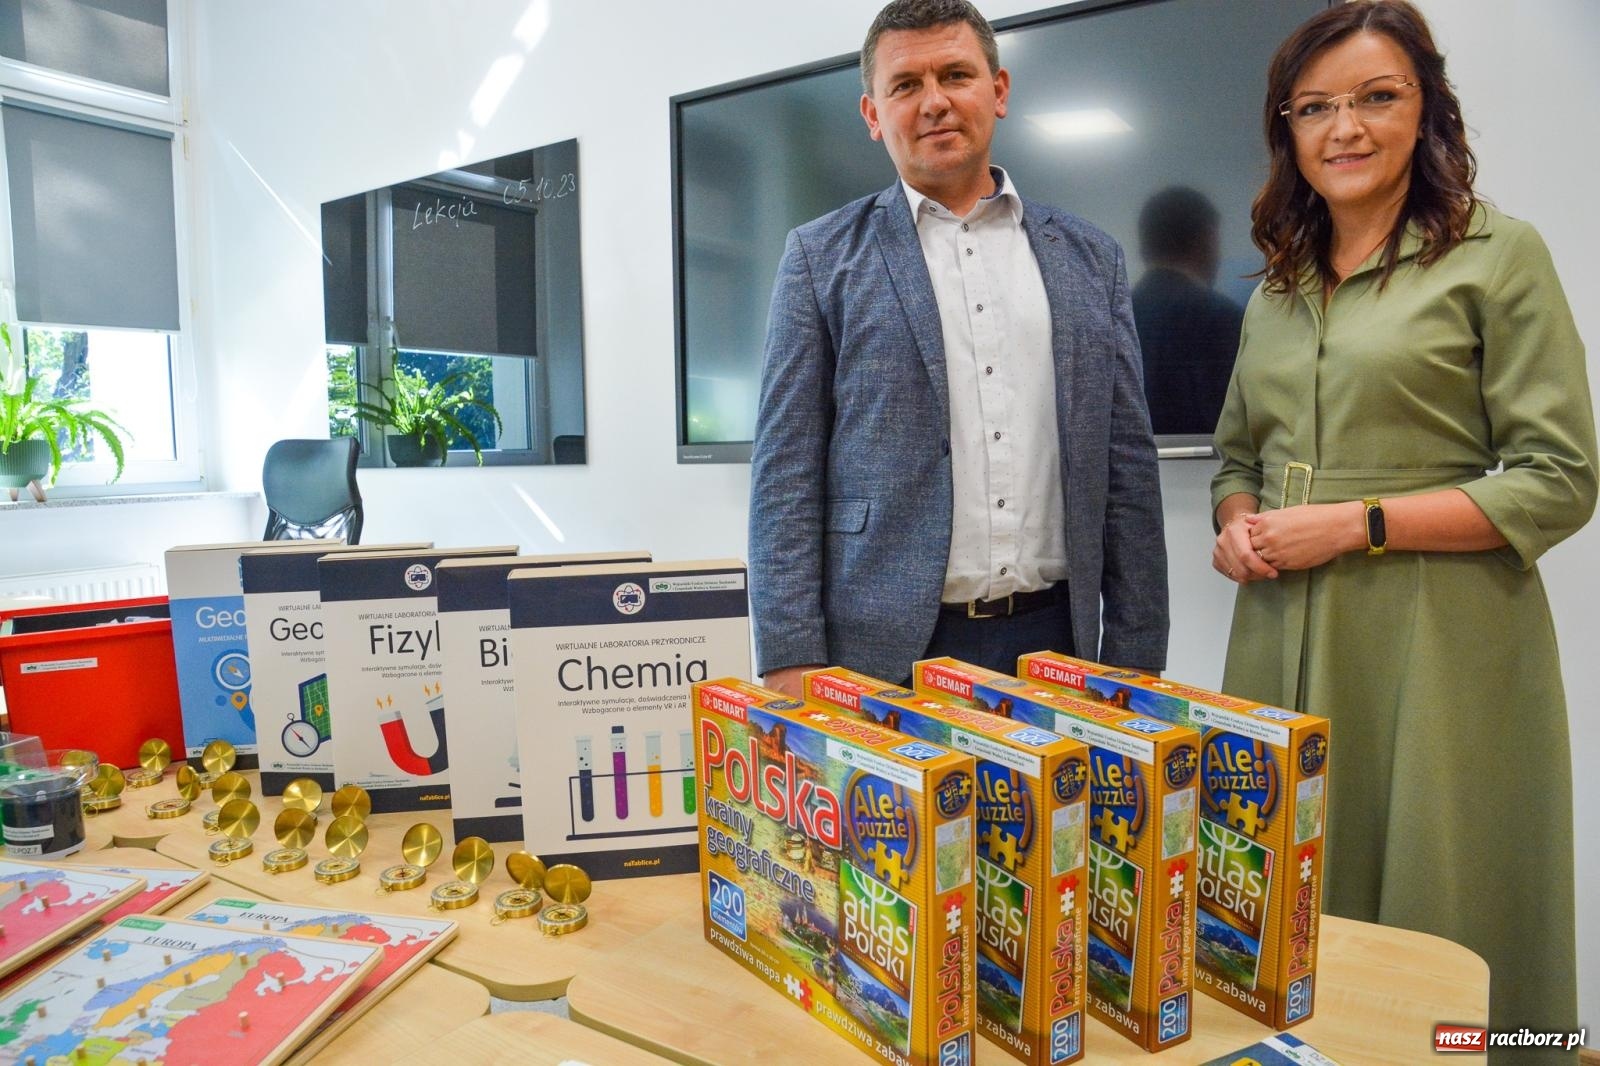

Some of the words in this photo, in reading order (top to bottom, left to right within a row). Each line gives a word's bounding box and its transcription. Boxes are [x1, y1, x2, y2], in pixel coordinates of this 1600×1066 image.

[412, 195, 478, 230] Lekcja
[195, 606, 247, 629] Geo
[358, 612, 393, 620] WIRTUALNE
[394, 610, 437, 619] LABORATORIA
[556, 641, 598, 651] WIRTUALNE
[599, 639, 650, 649] LABORATORIA
[651, 635, 706, 646] PRZYRODNICZE
[557, 653, 708, 692] Chemia
[936, 677, 971, 698] DEMART
[1043, 666, 1083, 687] DEMART
[557, 699, 600, 708] Interaktywne
[581, 705, 625, 715] Wzbogacone
[712, 696, 745, 721] DEMART
[824, 686, 859, 709] DEMART
[700, 717, 843, 851] Polska
[1092, 788, 1136, 807] uzzle
[1209, 773, 1268, 793] puzzle
[703, 786, 753, 842] krainy
[856, 818, 908, 840] puzzle
[706, 824, 816, 903] geograficzne
[710, 878, 743, 917] 200
[843, 884, 910, 957] atlas
[1074, 907, 1083, 973] geograficzne
[1182, 890, 1192, 955] geograficzne
[1287, 884, 1312, 978] Polska
[143, 935, 200, 951] EUROPA
[710, 927, 755, 966] prawdziwa
[755, 958, 781, 983] mapa
[961, 925, 972, 992] geograficzne
[1158, 900, 1183, 996] Polska
[1049, 917, 1075, 1017] Polska
[936, 936, 962, 1039] Polska
[1215, 978, 1267, 1014] zabawa
[1288, 981, 1304, 1019] 200
[816, 1000, 873, 1047] prawdziwa
[1095, 997, 1140, 1035] zabawa
[1161, 999, 1178, 1040] 200
[985, 1018, 1031, 1057] zabawa
[1053, 1019, 1069, 1060] 200
